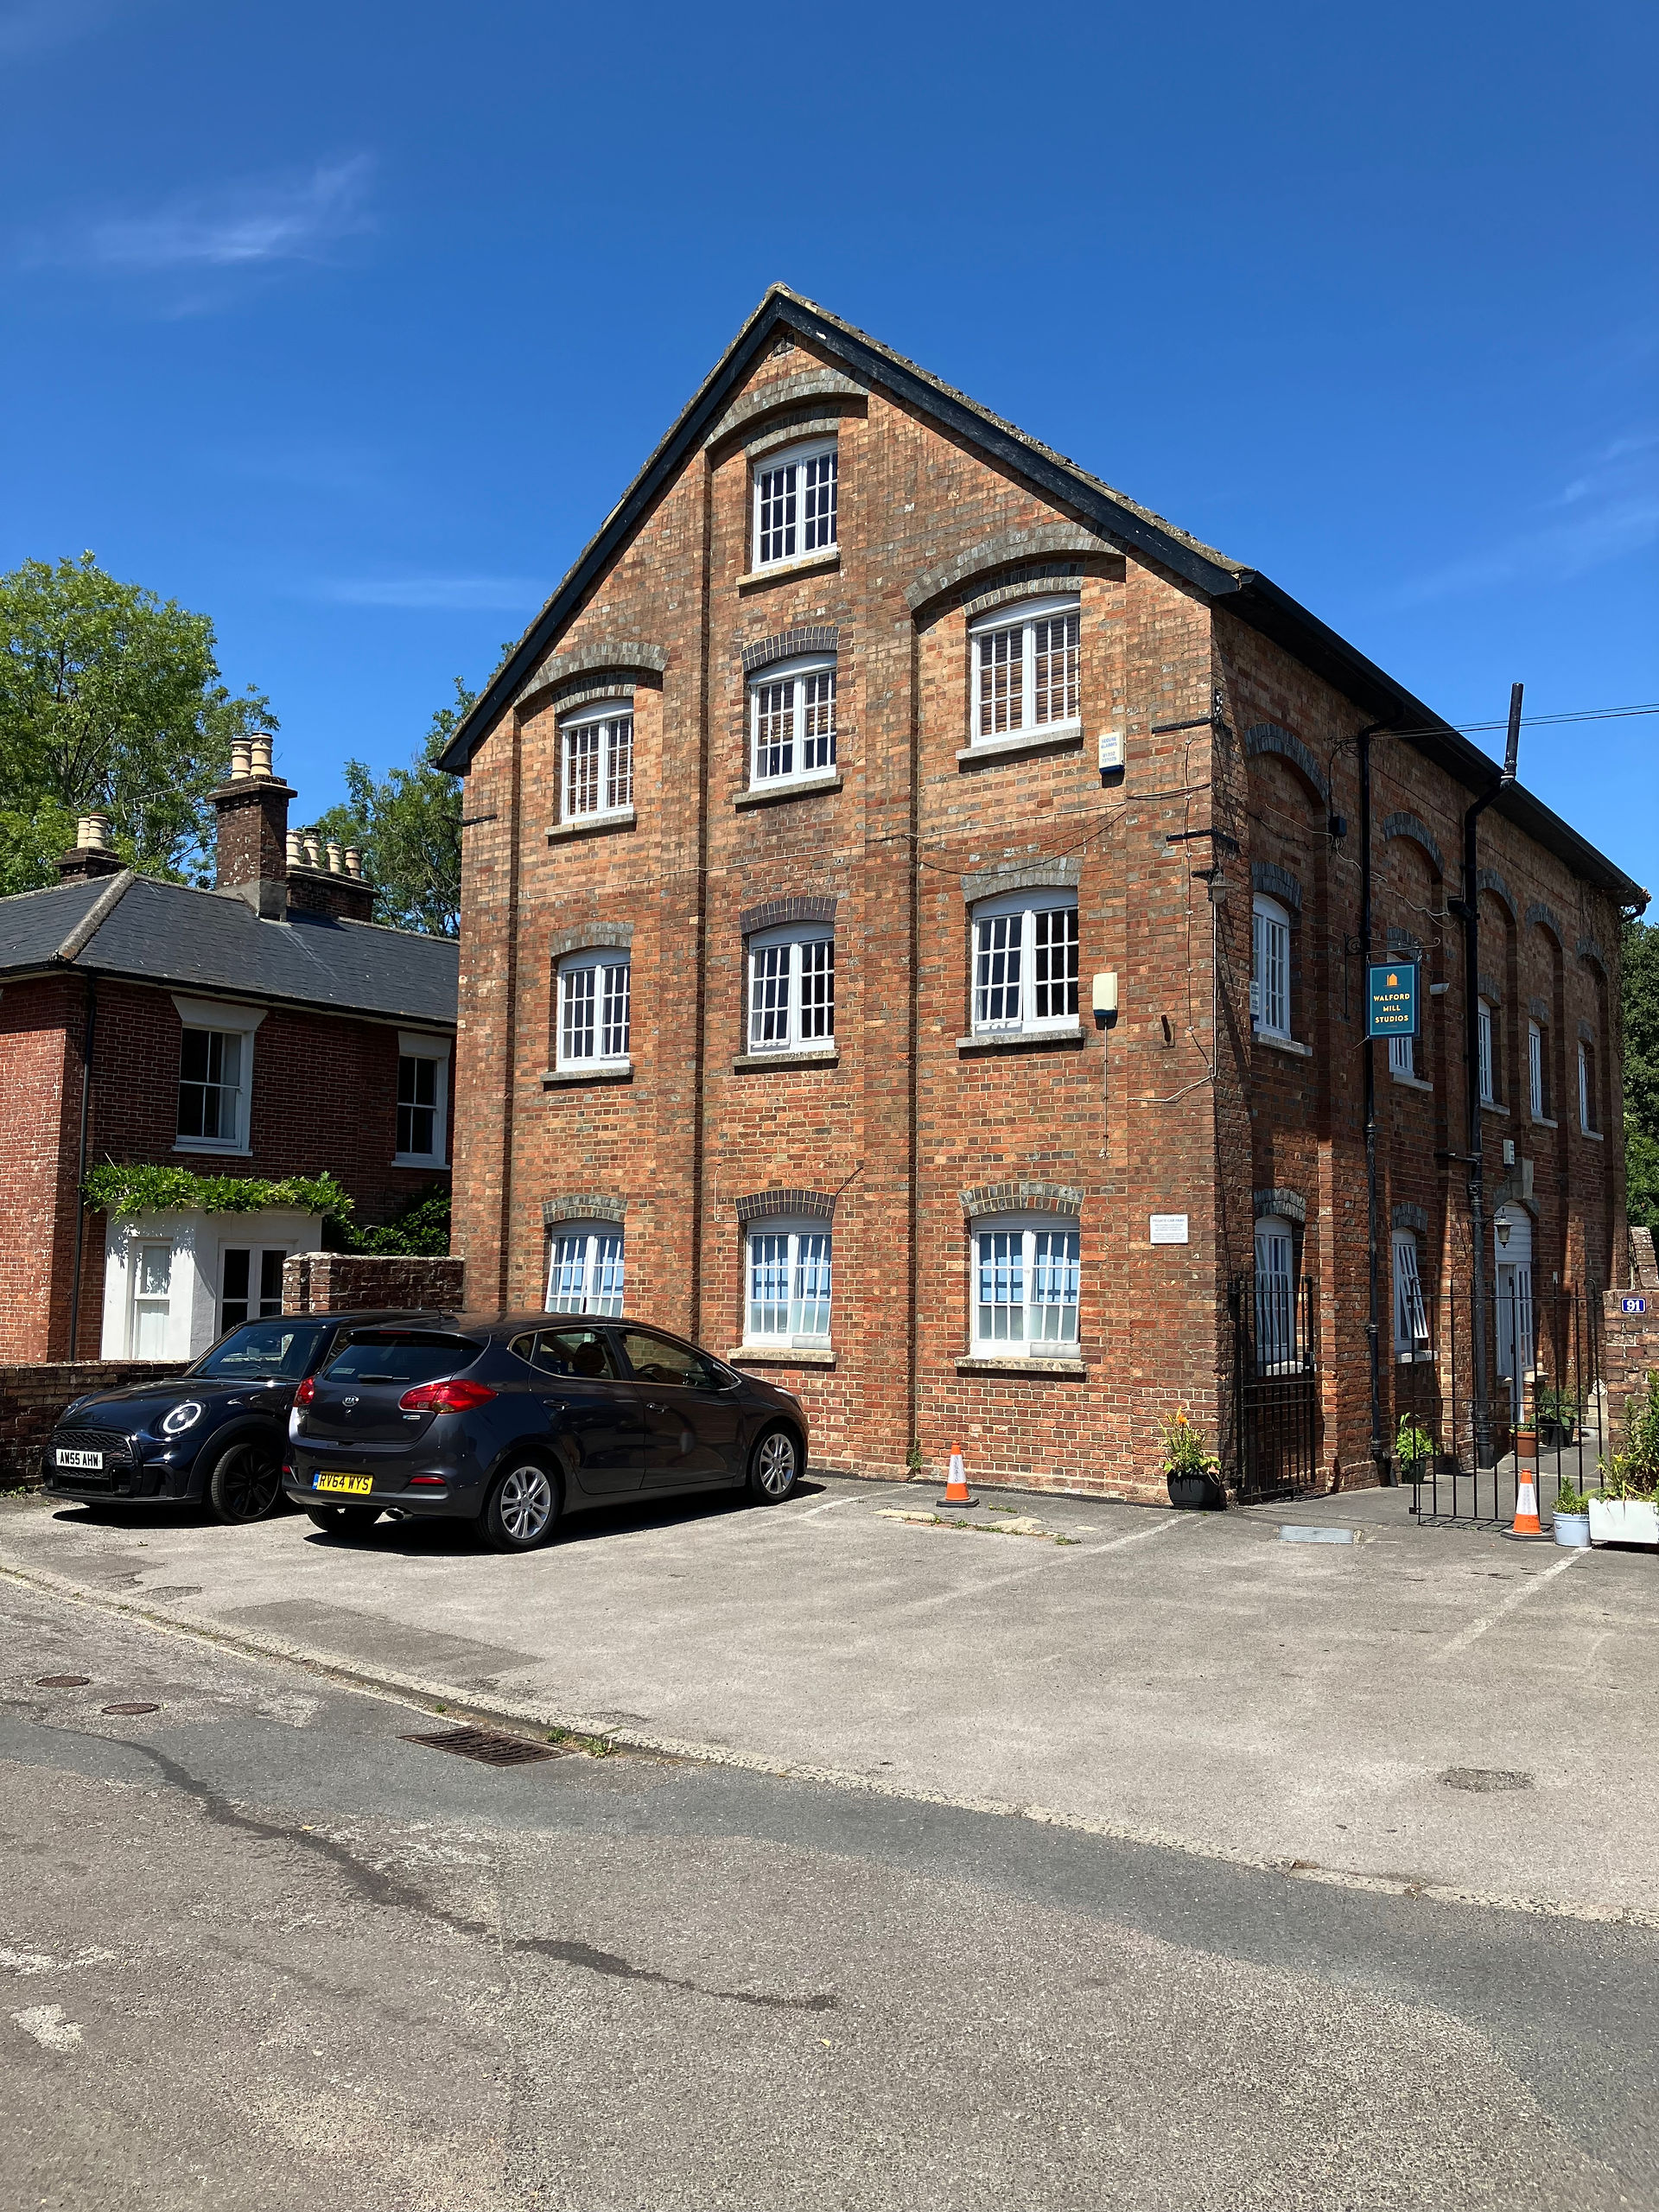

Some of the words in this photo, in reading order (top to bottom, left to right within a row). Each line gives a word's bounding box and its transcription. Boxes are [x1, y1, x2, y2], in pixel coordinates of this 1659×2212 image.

[1373, 993, 1410, 1001] WALFORD
[1375, 1014, 1409, 1023] STUDIOS
[1626, 1300, 1641, 1312] 91
[318, 1473, 345, 1489] RV64
[348, 1475, 370, 1491] WYS
